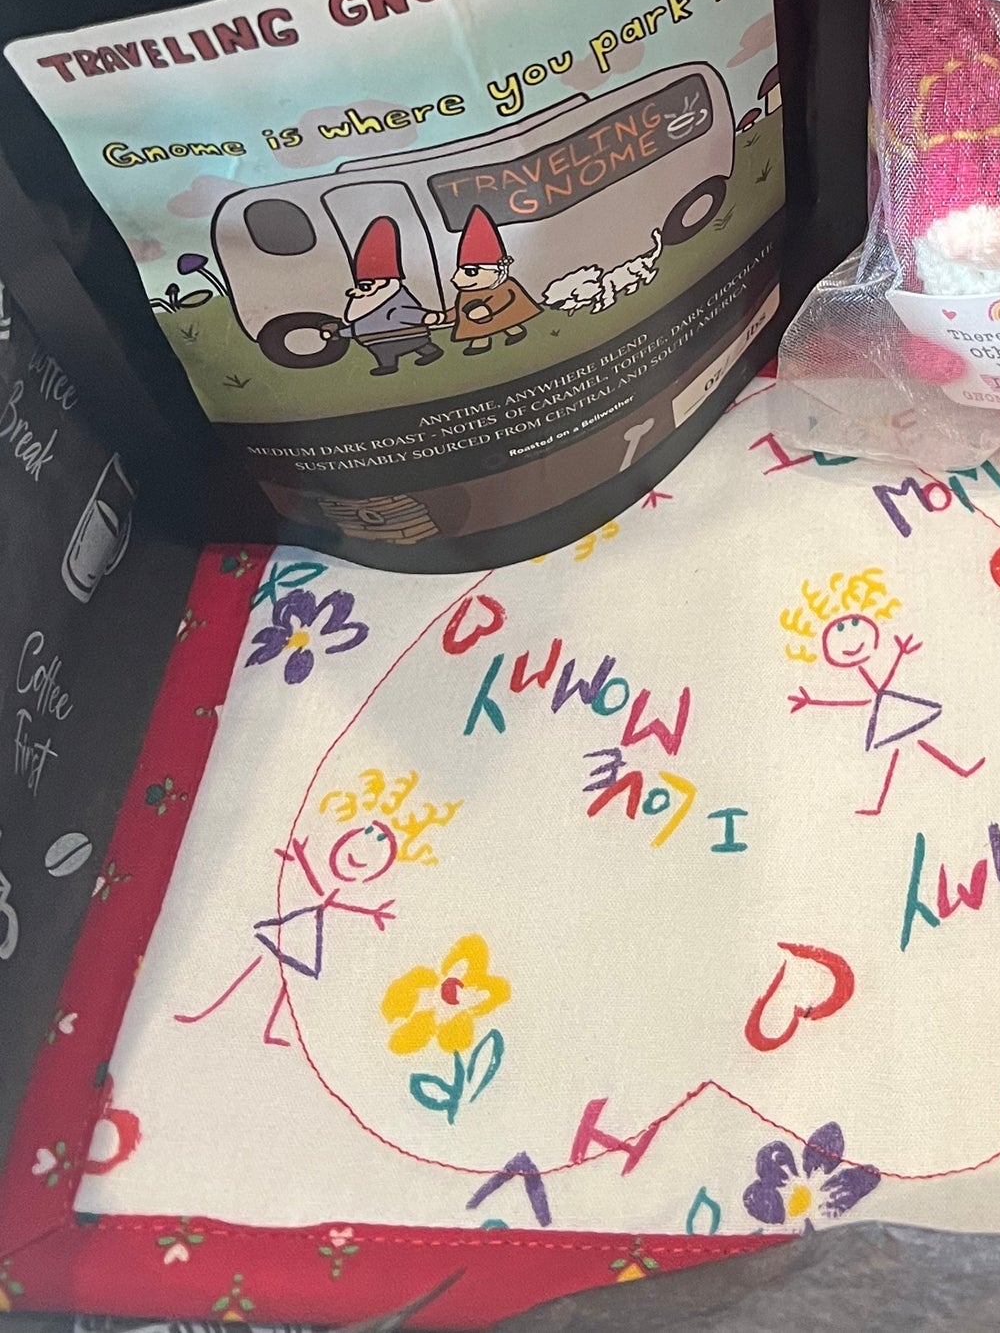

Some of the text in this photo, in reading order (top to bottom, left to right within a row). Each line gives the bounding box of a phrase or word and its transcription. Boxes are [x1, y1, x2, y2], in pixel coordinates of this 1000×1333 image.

[37, 7, 300, 83] TRAVELING
[102, 140, 247, 168] Gnome
[261, 124, 303, 152] is
[317, 94, 466, 143] where
[487, 50, 574, 117] you
[438, 103, 661, 197] TRAVELING
[508, 137, 660, 215] GNOME
[247, 445, 316, 458] MEDIUM
[320, 442, 367, 457] DARK
[371, 432, 425, 448] ROAST
[440, 414, 498, 438] NOTES
[504, 404, 529, 421] OF
[530, 373, 610, 413] CARAMEL,
[669, 305, 706, 337] DARK
[294, 283, 748, 472] SUSTAINABLY SOURCED FROM CENTRAL AND SOUTH AMERICA
[418, 333, 649, 428] ANYTIME, ANYWHERE BLEND
[509, 435, 555, 457] Roasted
[556, 428, 571, 439] on
[573, 424, 581, 433] a
[581, 395, 636, 429] Bellwether
[16, 630, 74, 721] Coffee
